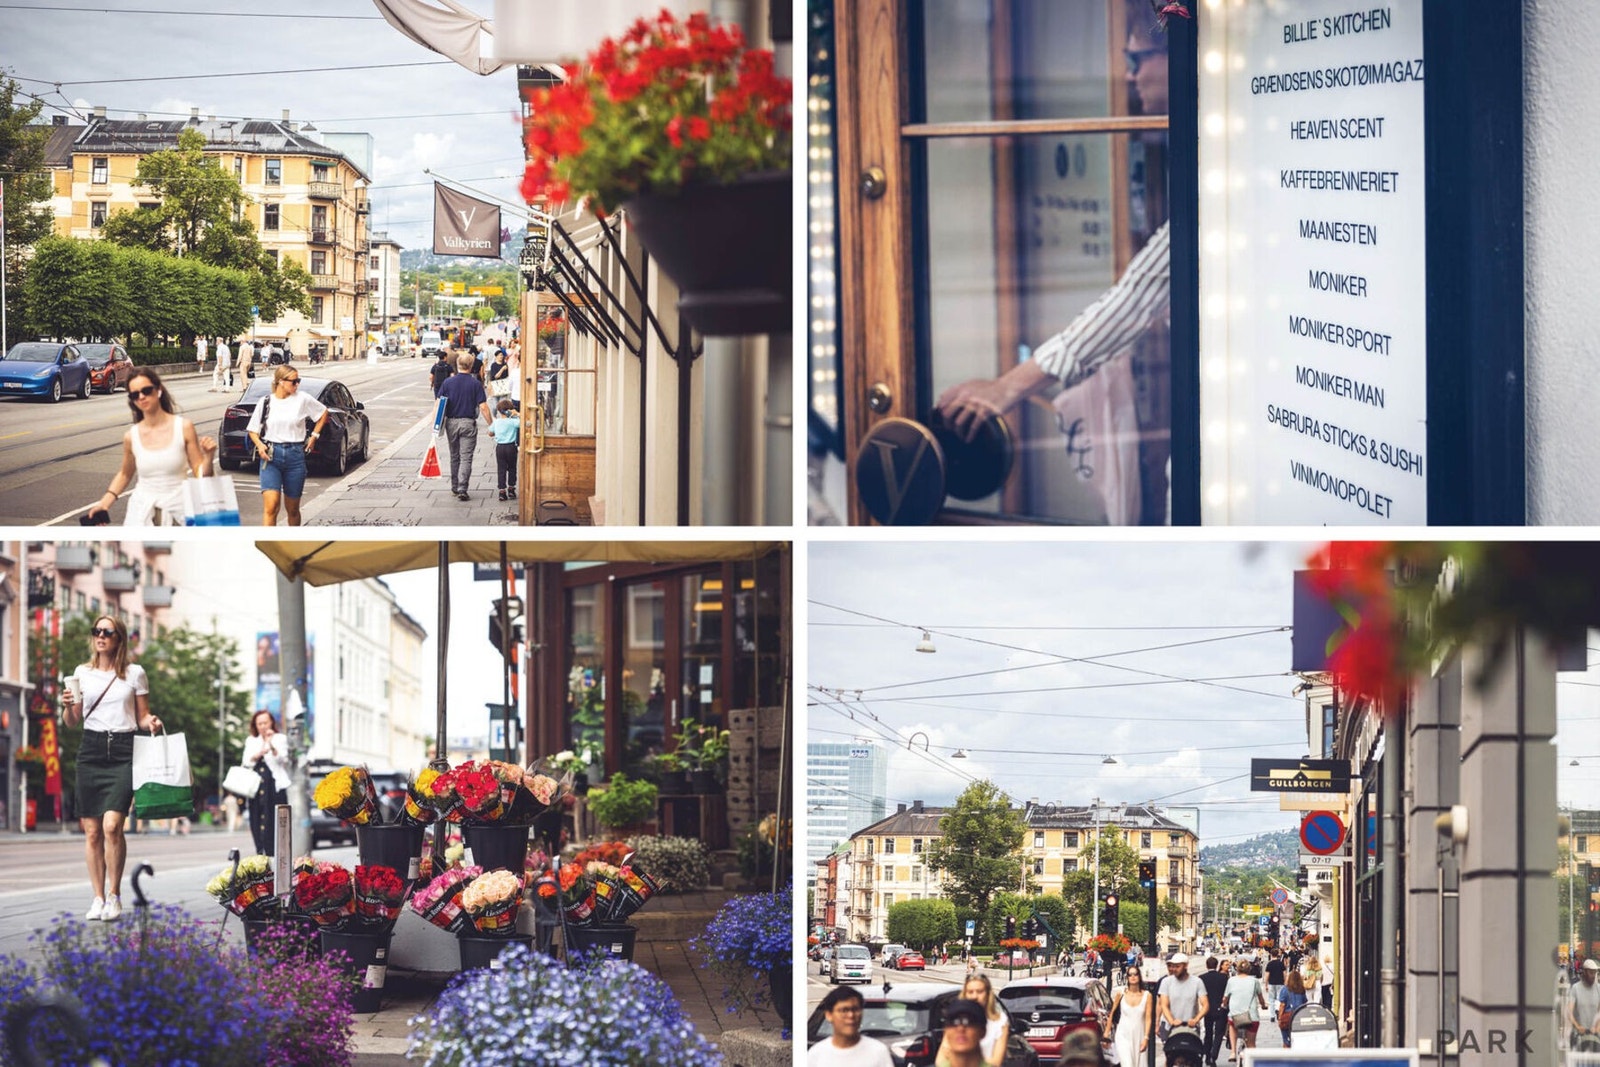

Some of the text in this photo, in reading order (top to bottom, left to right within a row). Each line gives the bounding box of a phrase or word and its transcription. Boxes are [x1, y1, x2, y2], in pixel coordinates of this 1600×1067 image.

[1333, 8, 1391, 36] KITCHEN
[1251, 59, 1424, 95] GRÆNDSENS SKOTØIMAGAZ
[1291, 118, 1384, 140] HEAVEN SCENT
[1280, 170, 1399, 193] KAFFEBRENNERIET
[443, 236, 491, 250] Valkyrien
[1299, 219, 1377, 245] MAANESTEN
[1309, 269, 1367, 298] MONIKER
[1289, 315, 1392, 356] MONIKER SPORT
[1296, 365, 1385, 408] MONIKER MAN
[1267, 404, 1423, 476] SABRURA STICKS & SUSHI
[1290, 459, 1393, 519] VINMONOPOLET
[1269, 780, 1332, 788] GULLBORGEN
[1262, 916, 1268, 924] P
